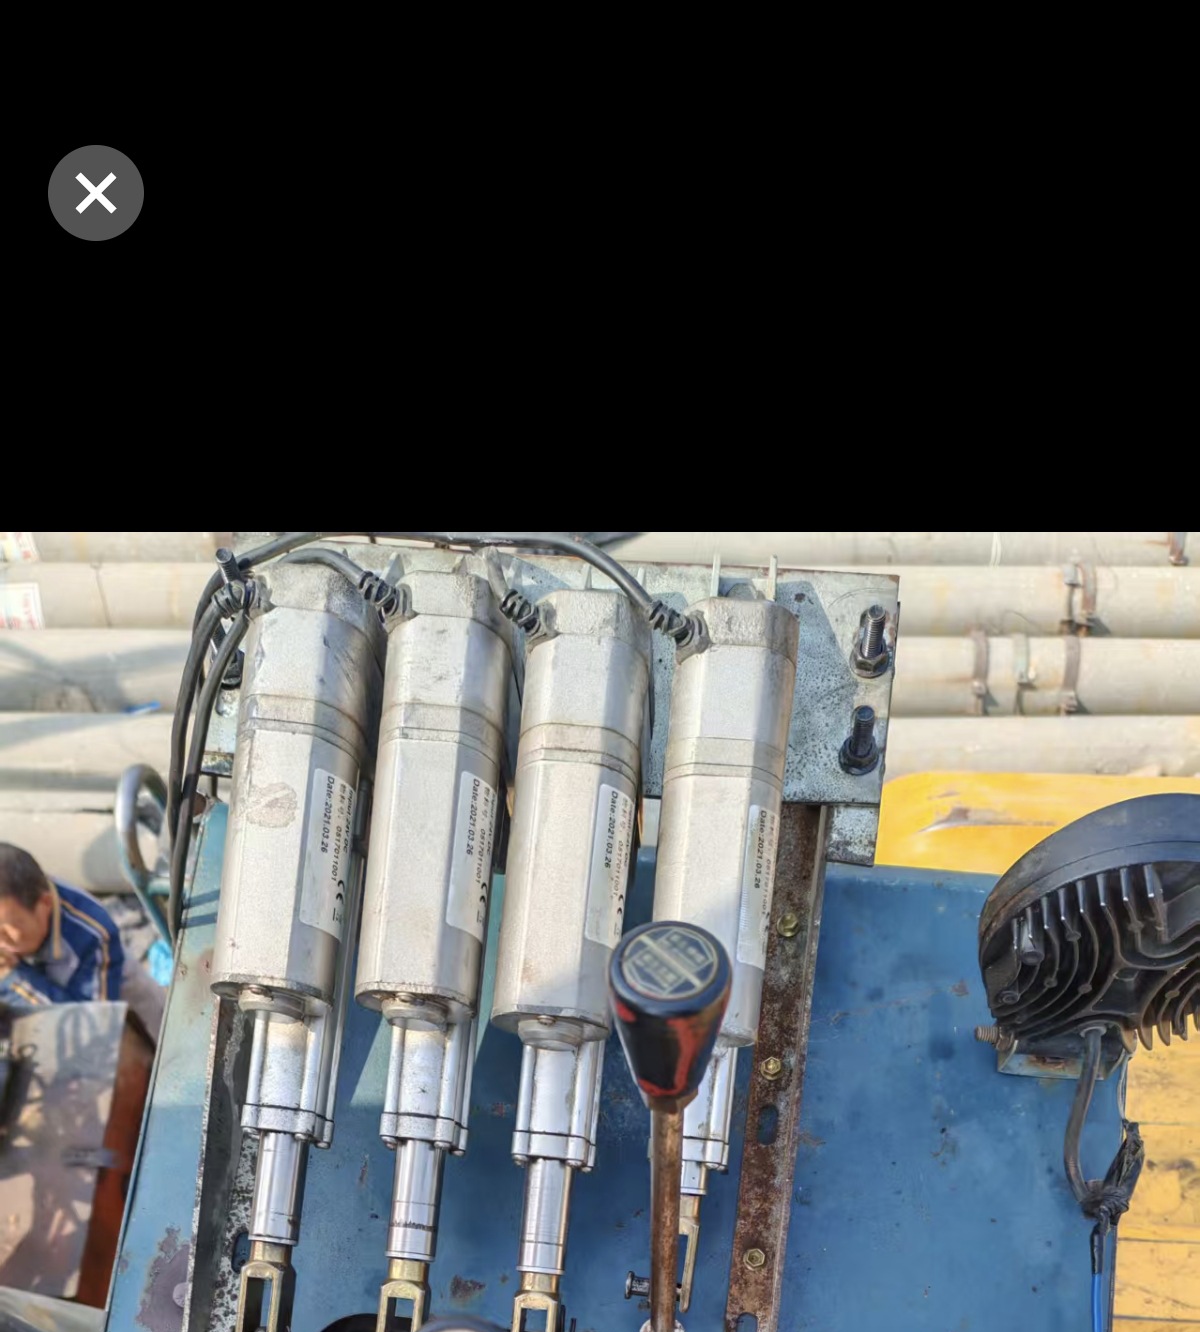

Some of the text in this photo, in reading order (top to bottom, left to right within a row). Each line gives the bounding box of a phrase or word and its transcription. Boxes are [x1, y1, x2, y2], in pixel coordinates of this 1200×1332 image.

[320, 776, 335, 854] Date:2021.03.26
[466, 778, 480, 855] Date:2021.03.26
[604, 791, 618, 869] Date:2021.03.26
[754, 810, 767, 889] Date:2021.03.26
